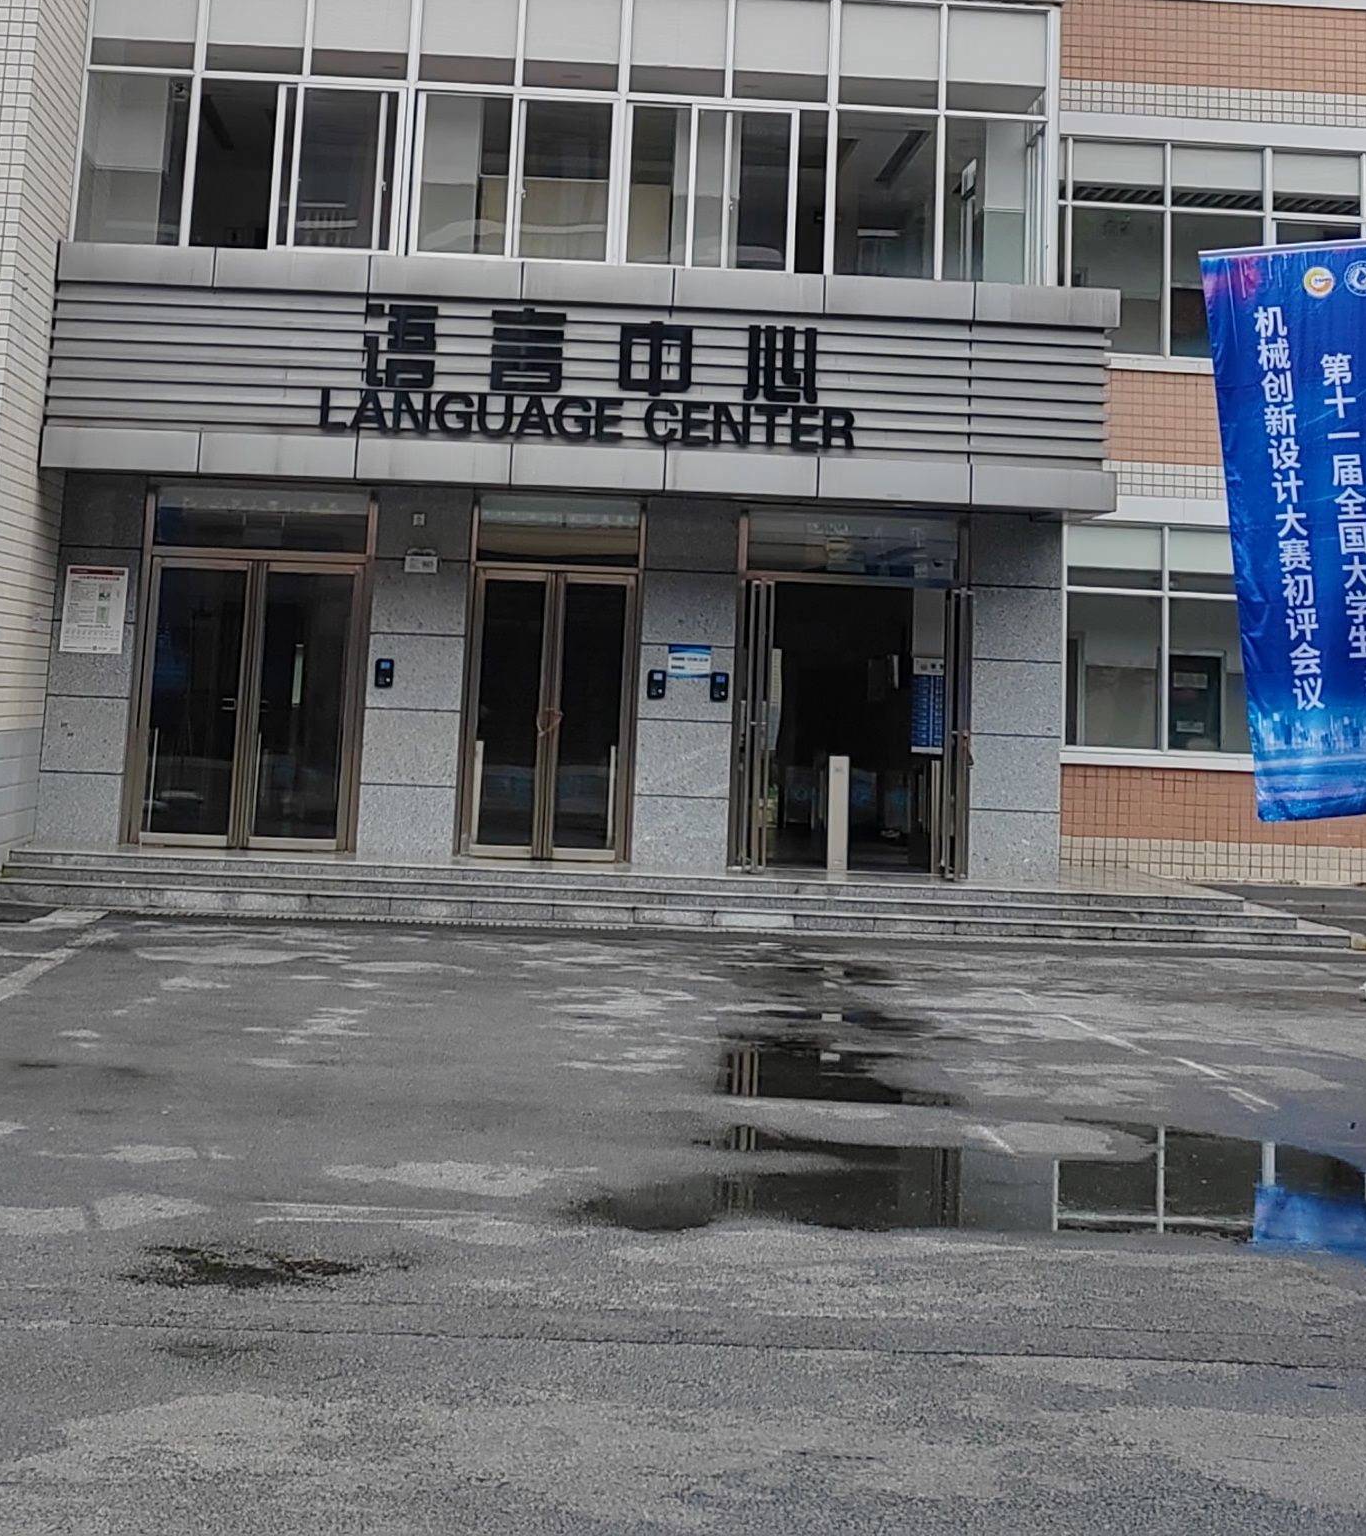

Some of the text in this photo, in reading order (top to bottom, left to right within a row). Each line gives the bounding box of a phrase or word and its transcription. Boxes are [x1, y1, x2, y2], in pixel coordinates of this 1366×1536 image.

[365, 302, 818, 403] 语言中心
[319, 388, 857, 451] LANGUAGE CENTER
[1253, 306, 1325, 711] 机械创新设计大赛初评会议
